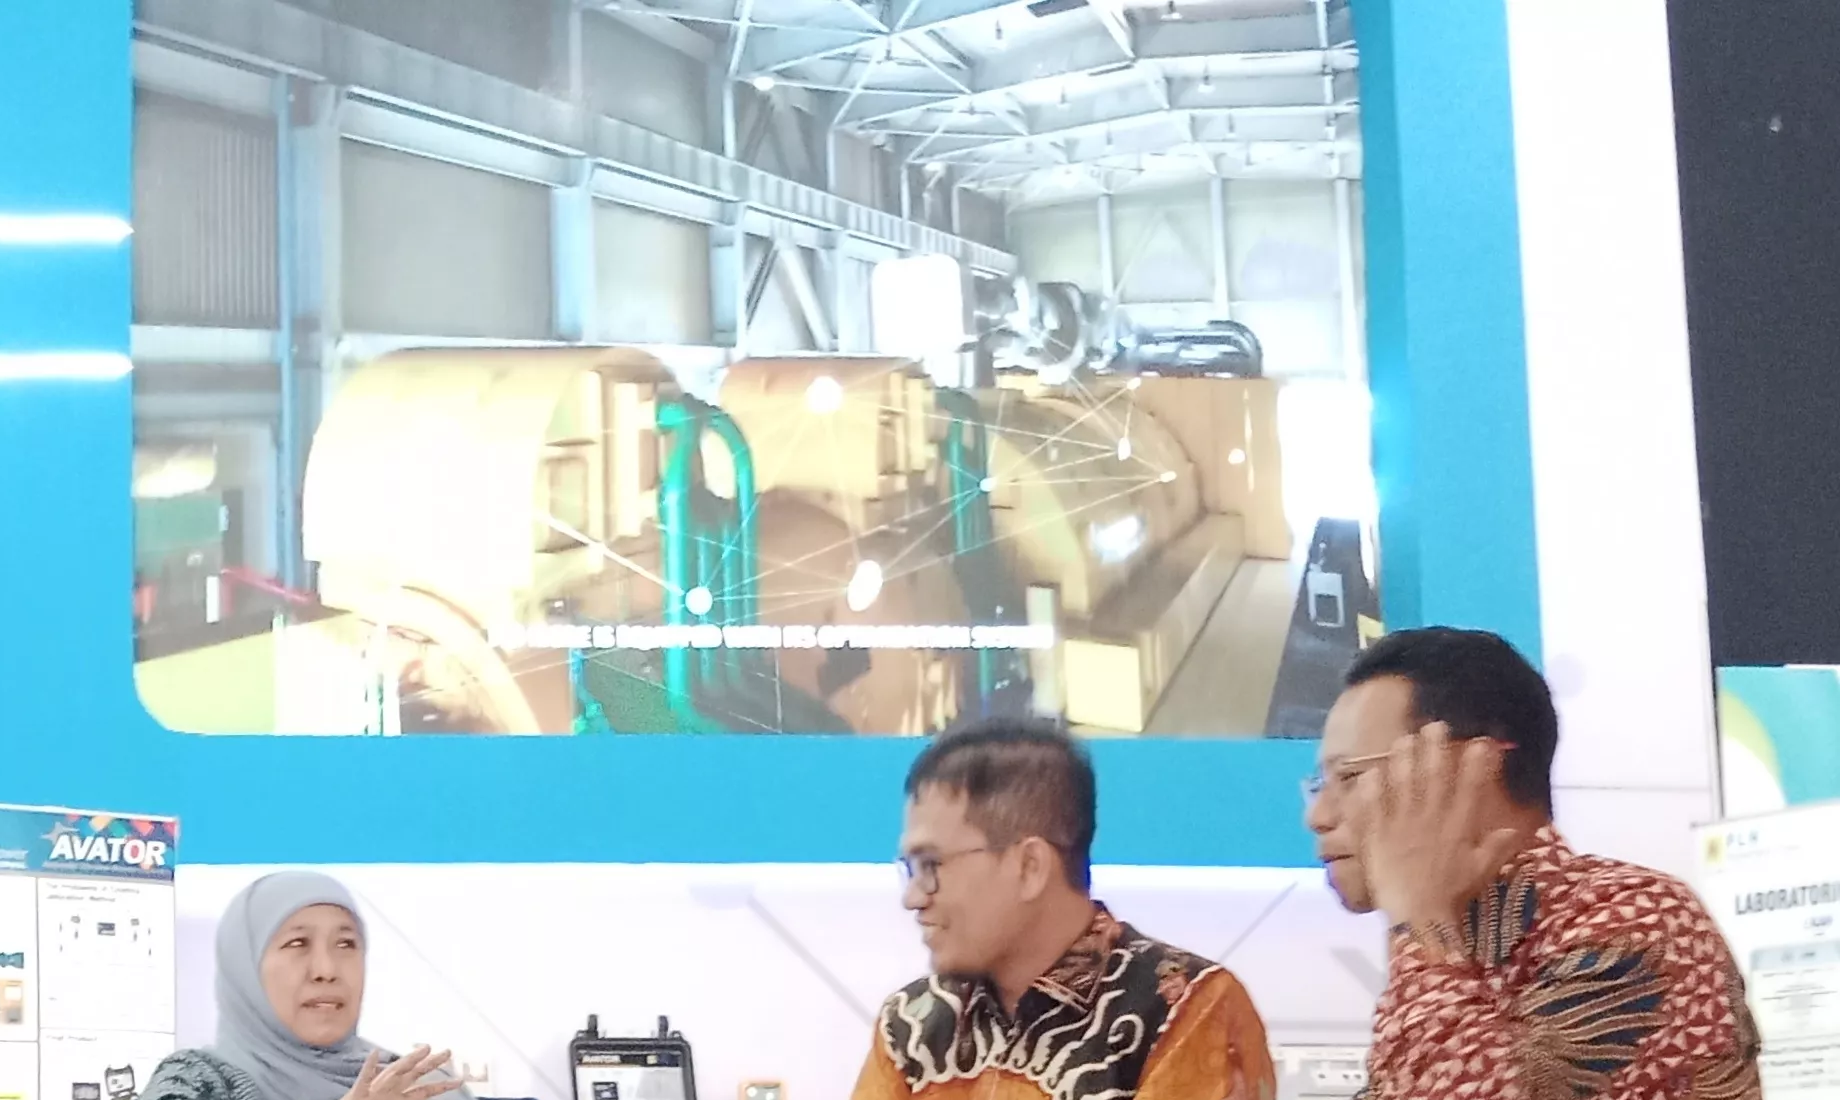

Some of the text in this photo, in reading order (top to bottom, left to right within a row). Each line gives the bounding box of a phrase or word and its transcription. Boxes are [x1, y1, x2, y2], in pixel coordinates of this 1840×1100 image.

[49, 833, 167, 867] AVATOR
[1726, 830, 1759, 847] PLN
[1734, 881, 1840, 916] LABORATORI
